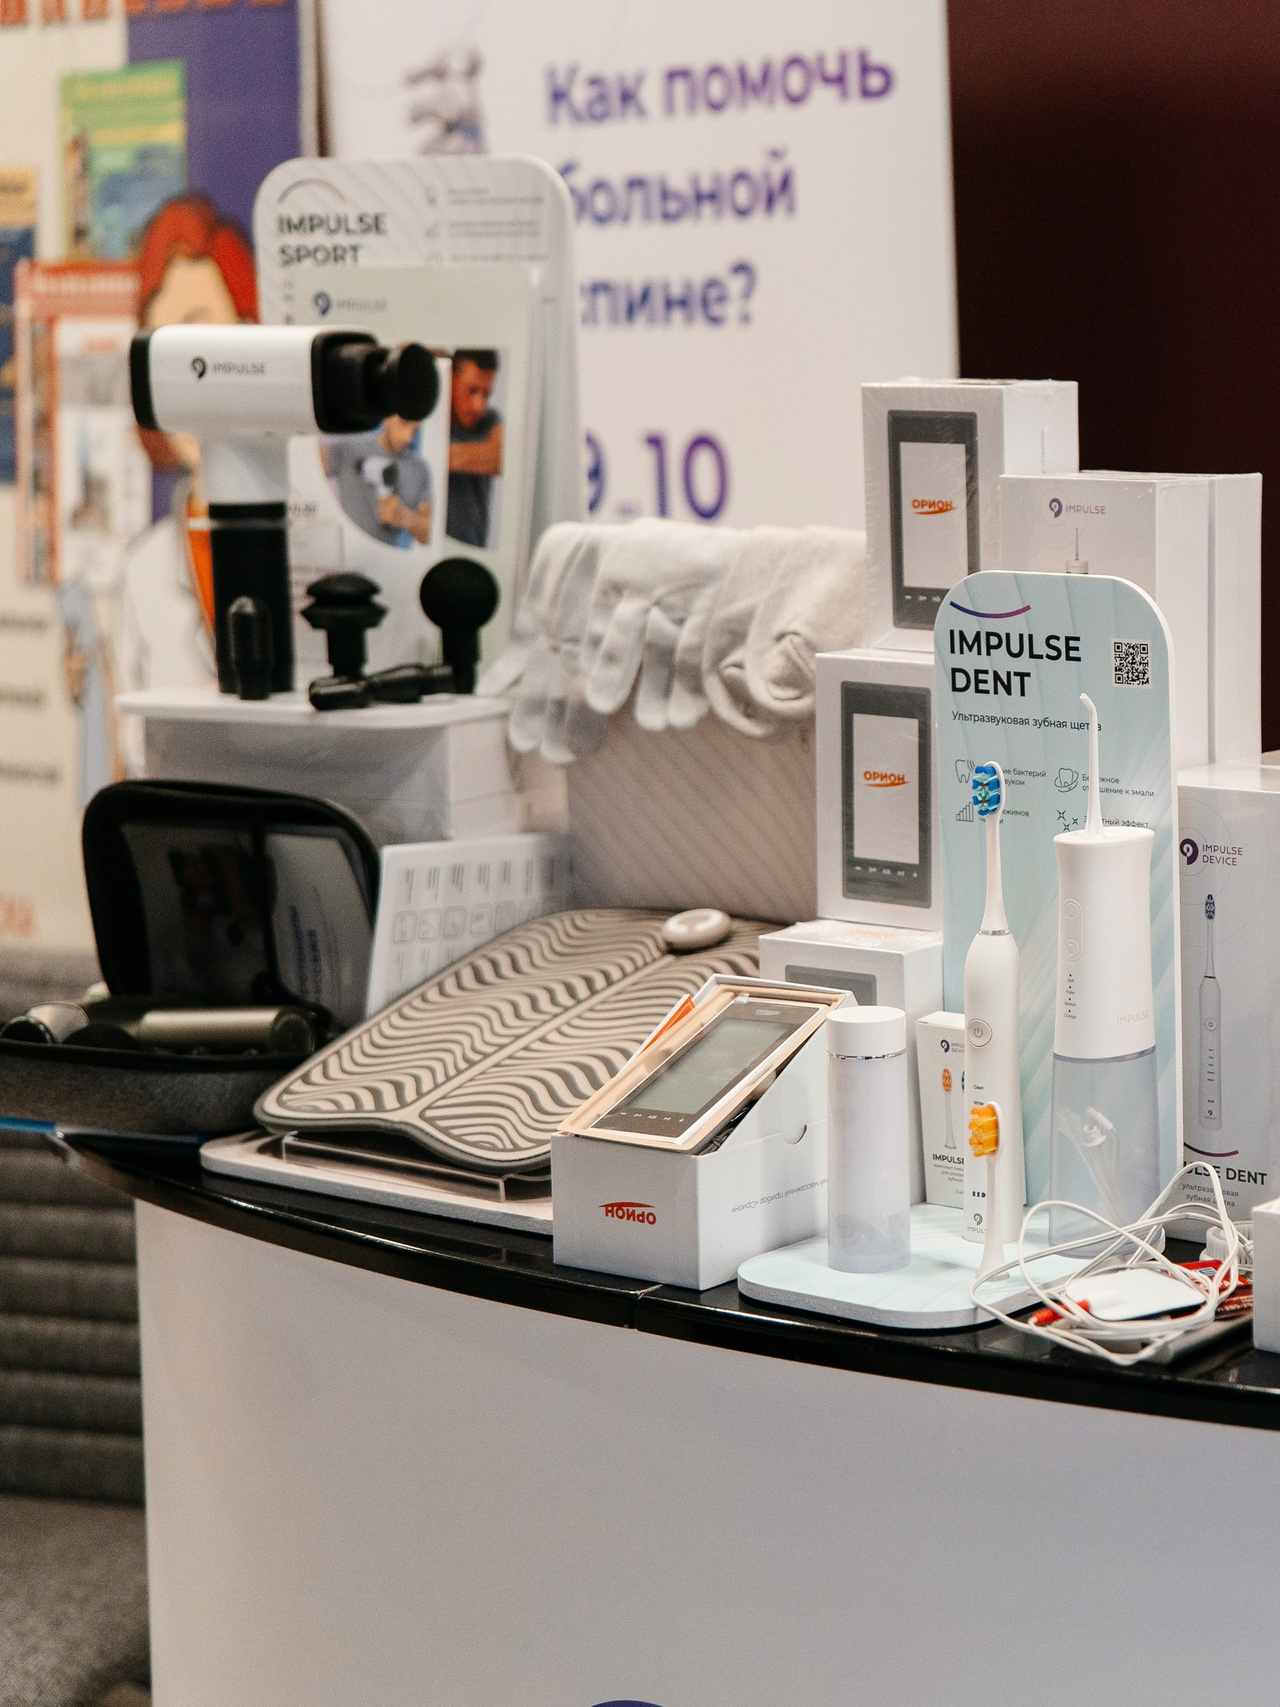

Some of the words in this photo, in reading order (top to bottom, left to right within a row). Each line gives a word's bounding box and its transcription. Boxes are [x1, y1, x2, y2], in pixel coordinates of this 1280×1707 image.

[547, 60, 647, 126] Как
[664, 47, 895, 116] помочь
[278, 212, 388, 235] IMPULSE
[280, 244, 362, 267] SPORT
[580, 260, 758, 328] пине?
[912, 498, 954, 511] ОРИОН
[1065, 504, 1106, 515] IMPULSE
[949, 628, 1082, 662] IMPULSE
[951, 667, 1031, 697] DENT
[951, 710, 1030, 726] Ультразвуковая
[1032, 716, 1068, 729] зубная
[1070, 720, 1102, 732] щета
[863, 770, 906, 784] ОРИОН
[1012, 768, 1047, 778] бактерий
[1131, 789, 1155, 797] эмали
[1121, 820, 1149, 828] эффект
[1202, 843, 1243, 856] IMPULSE
[1202, 854, 1238, 866] DEVICE
[1116, 1009, 1150, 1026] IMPULSE
[1226, 1167, 1267, 1185] DENT
[785, 1181, 819, 1198] массажный
[1182, 1183, 1239, 1197] ультразвовая
[759, 1190, 783, 1205] прибор
[1185, 1193, 1211, 1202] зубная
[731, 1199, 759, 1212] «Орион»
[603, 1205, 658, 1226] ОРИОН
[967, 1226, 987, 1234] IMPUL
